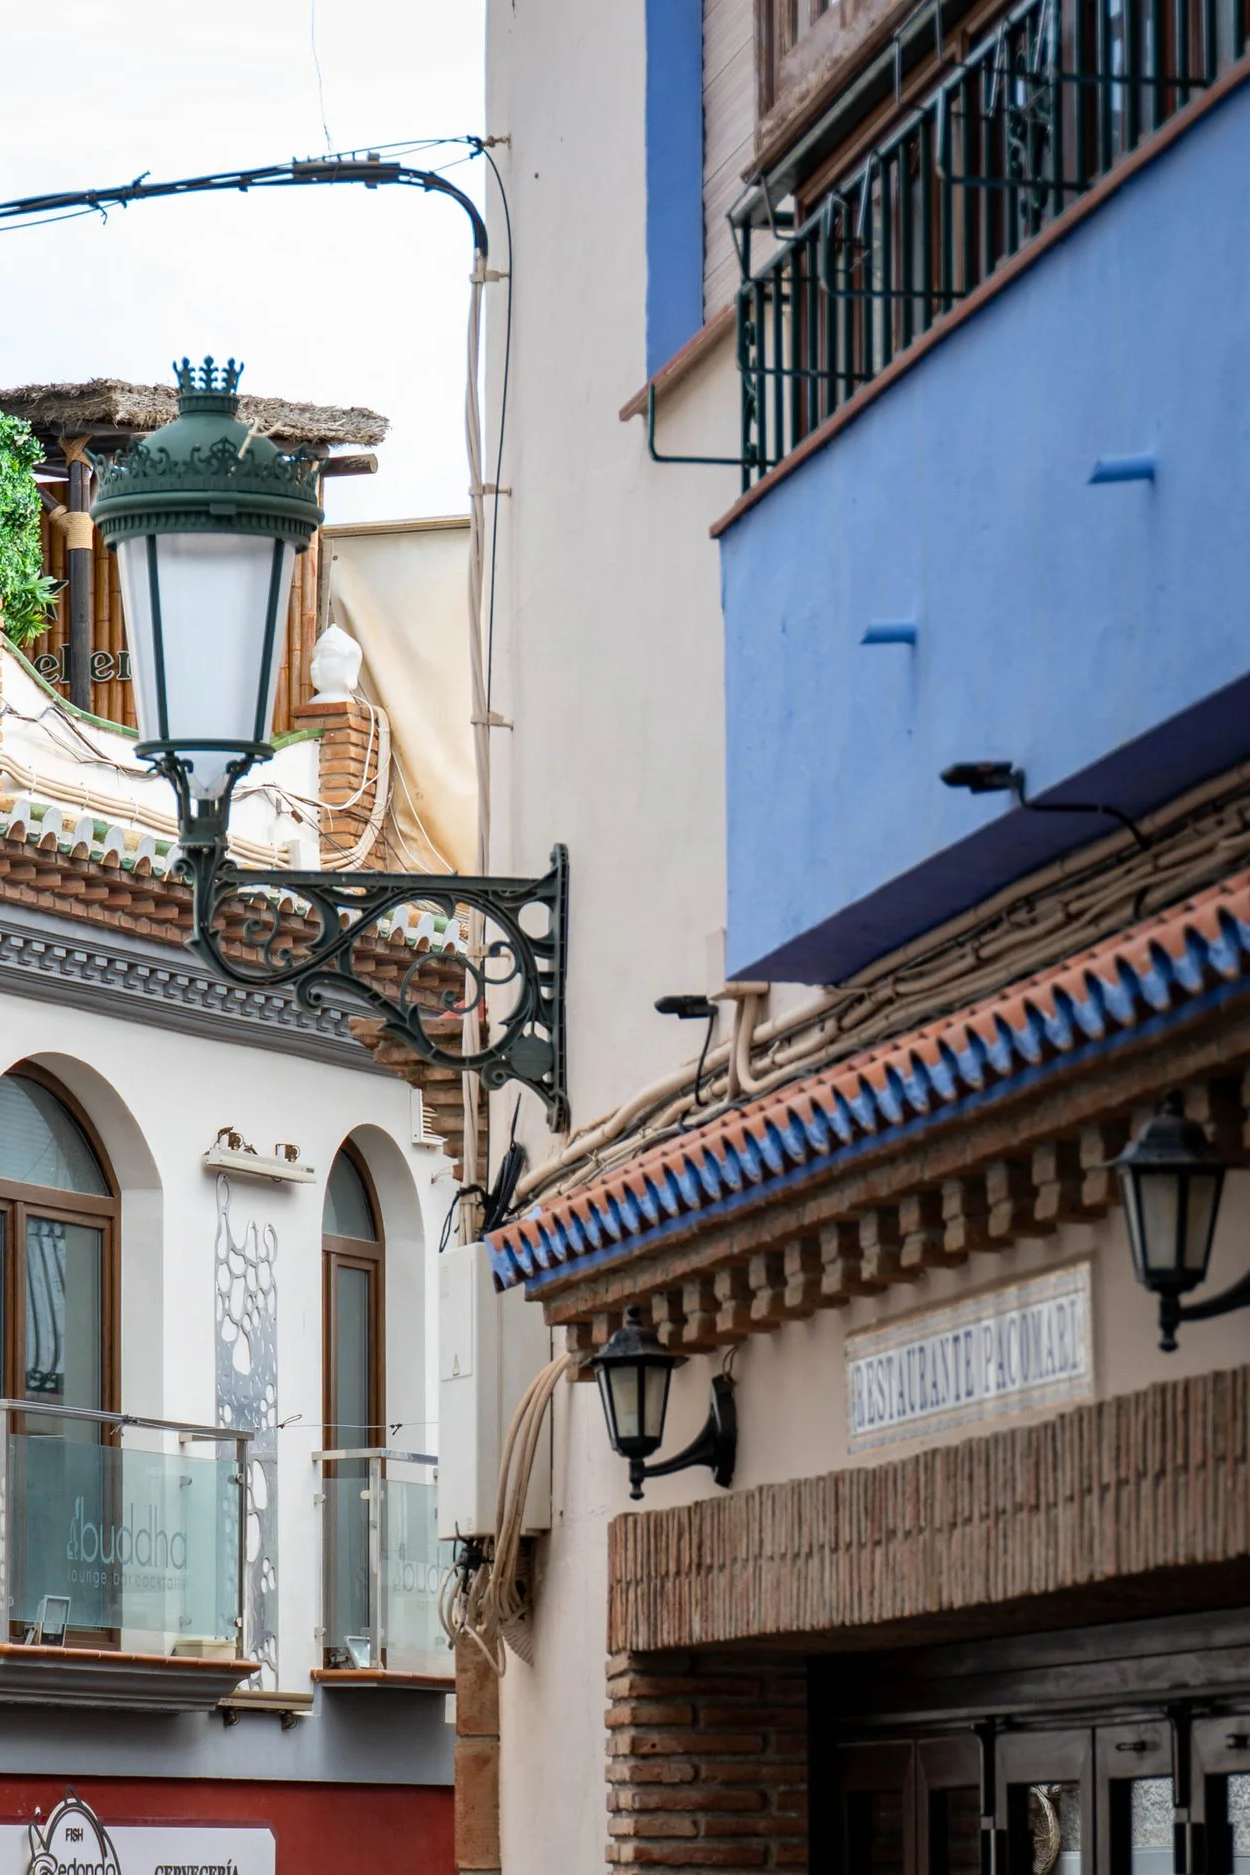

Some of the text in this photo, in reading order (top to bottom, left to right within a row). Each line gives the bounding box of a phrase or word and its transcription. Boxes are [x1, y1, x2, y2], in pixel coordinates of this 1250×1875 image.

[853, 1330, 975, 1428] RESTAURANTE
[80, 1496, 187, 1570] buddha
[67, 1566, 108, 1588] lounge
[65, 1827, 84, 1842] FISH
